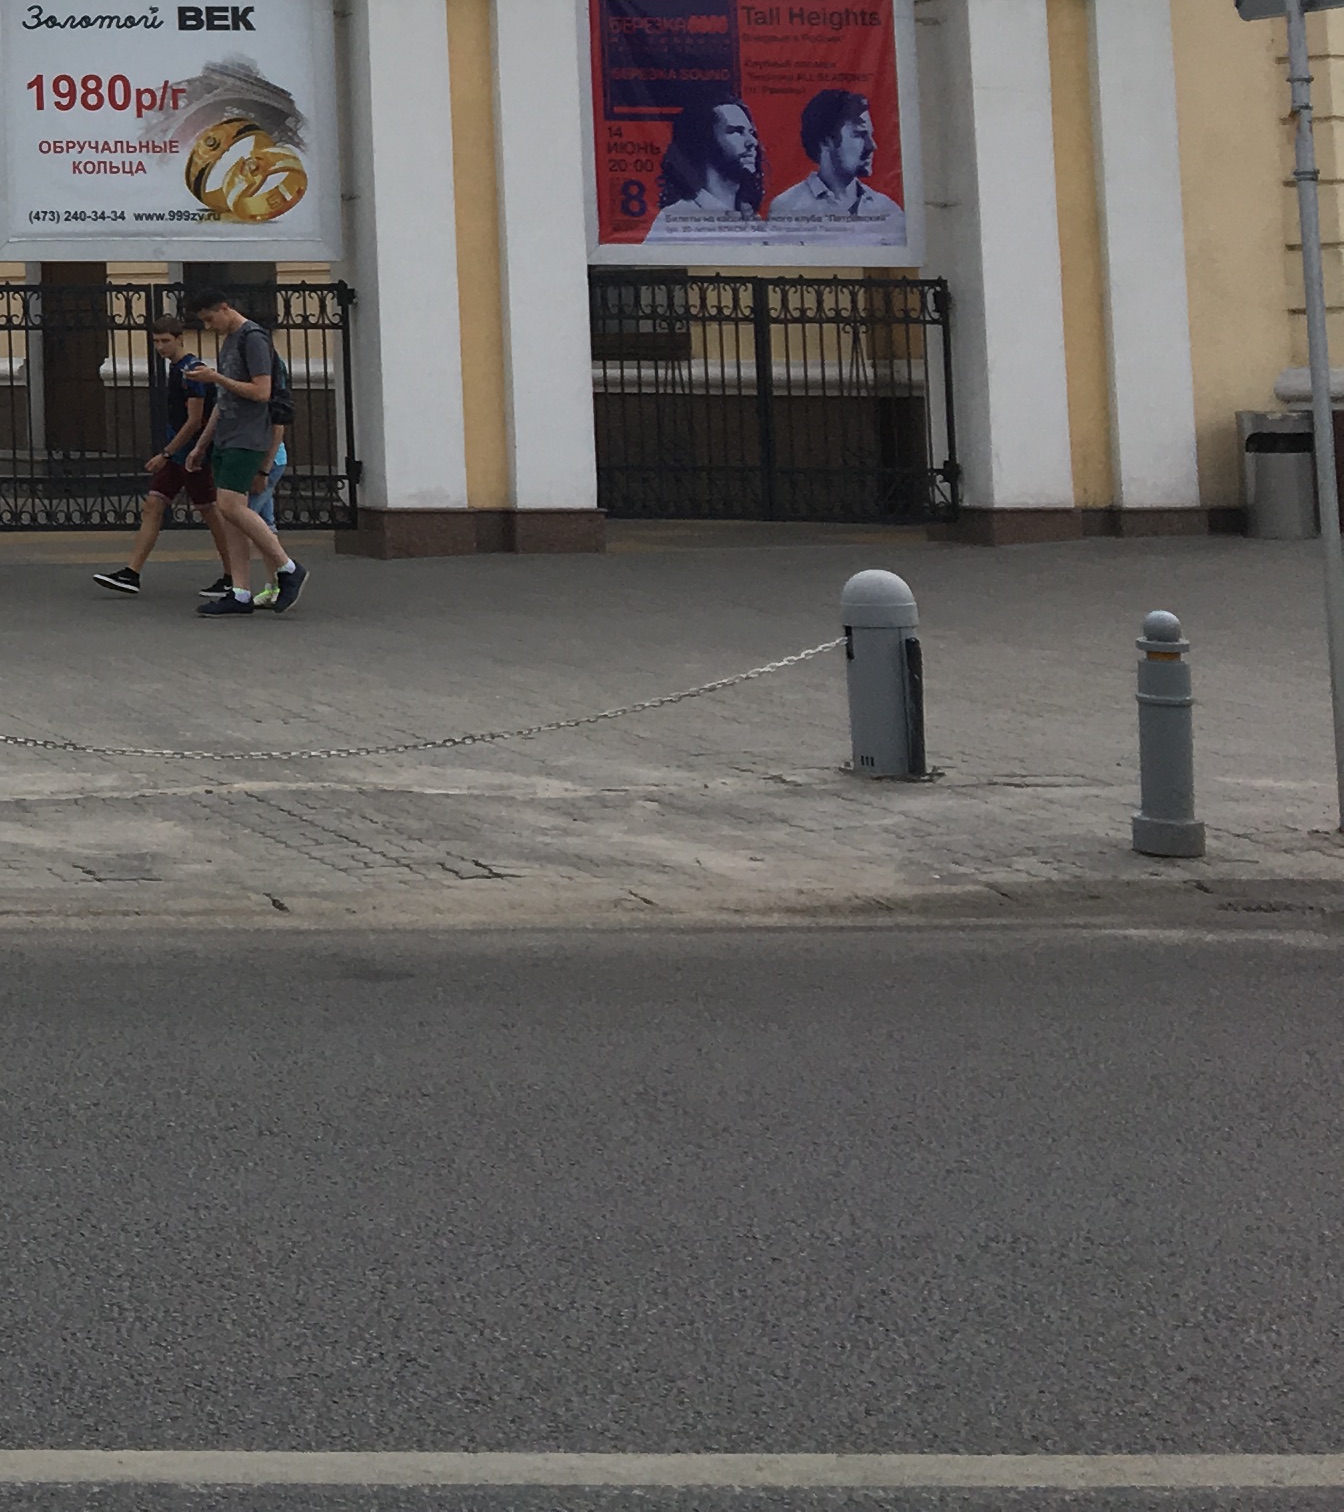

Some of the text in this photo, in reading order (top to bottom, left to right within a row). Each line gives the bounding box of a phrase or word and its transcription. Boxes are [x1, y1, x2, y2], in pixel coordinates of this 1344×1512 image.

[22, 4, 256, 31] Золотой ВЕК
[741, 6, 882, 31] Tall Heights
[26, 74, 187, 118] 1980р/г
[38, 140, 180, 155] ОБРУЧАЛЬНЫЕ
[607, 141, 662, 155] ИЮНЬ
[72, 160, 147, 176] КОЛЬЦА
[28, 210, 221, 224] (473) 240-34-34 www.999zv.ru
